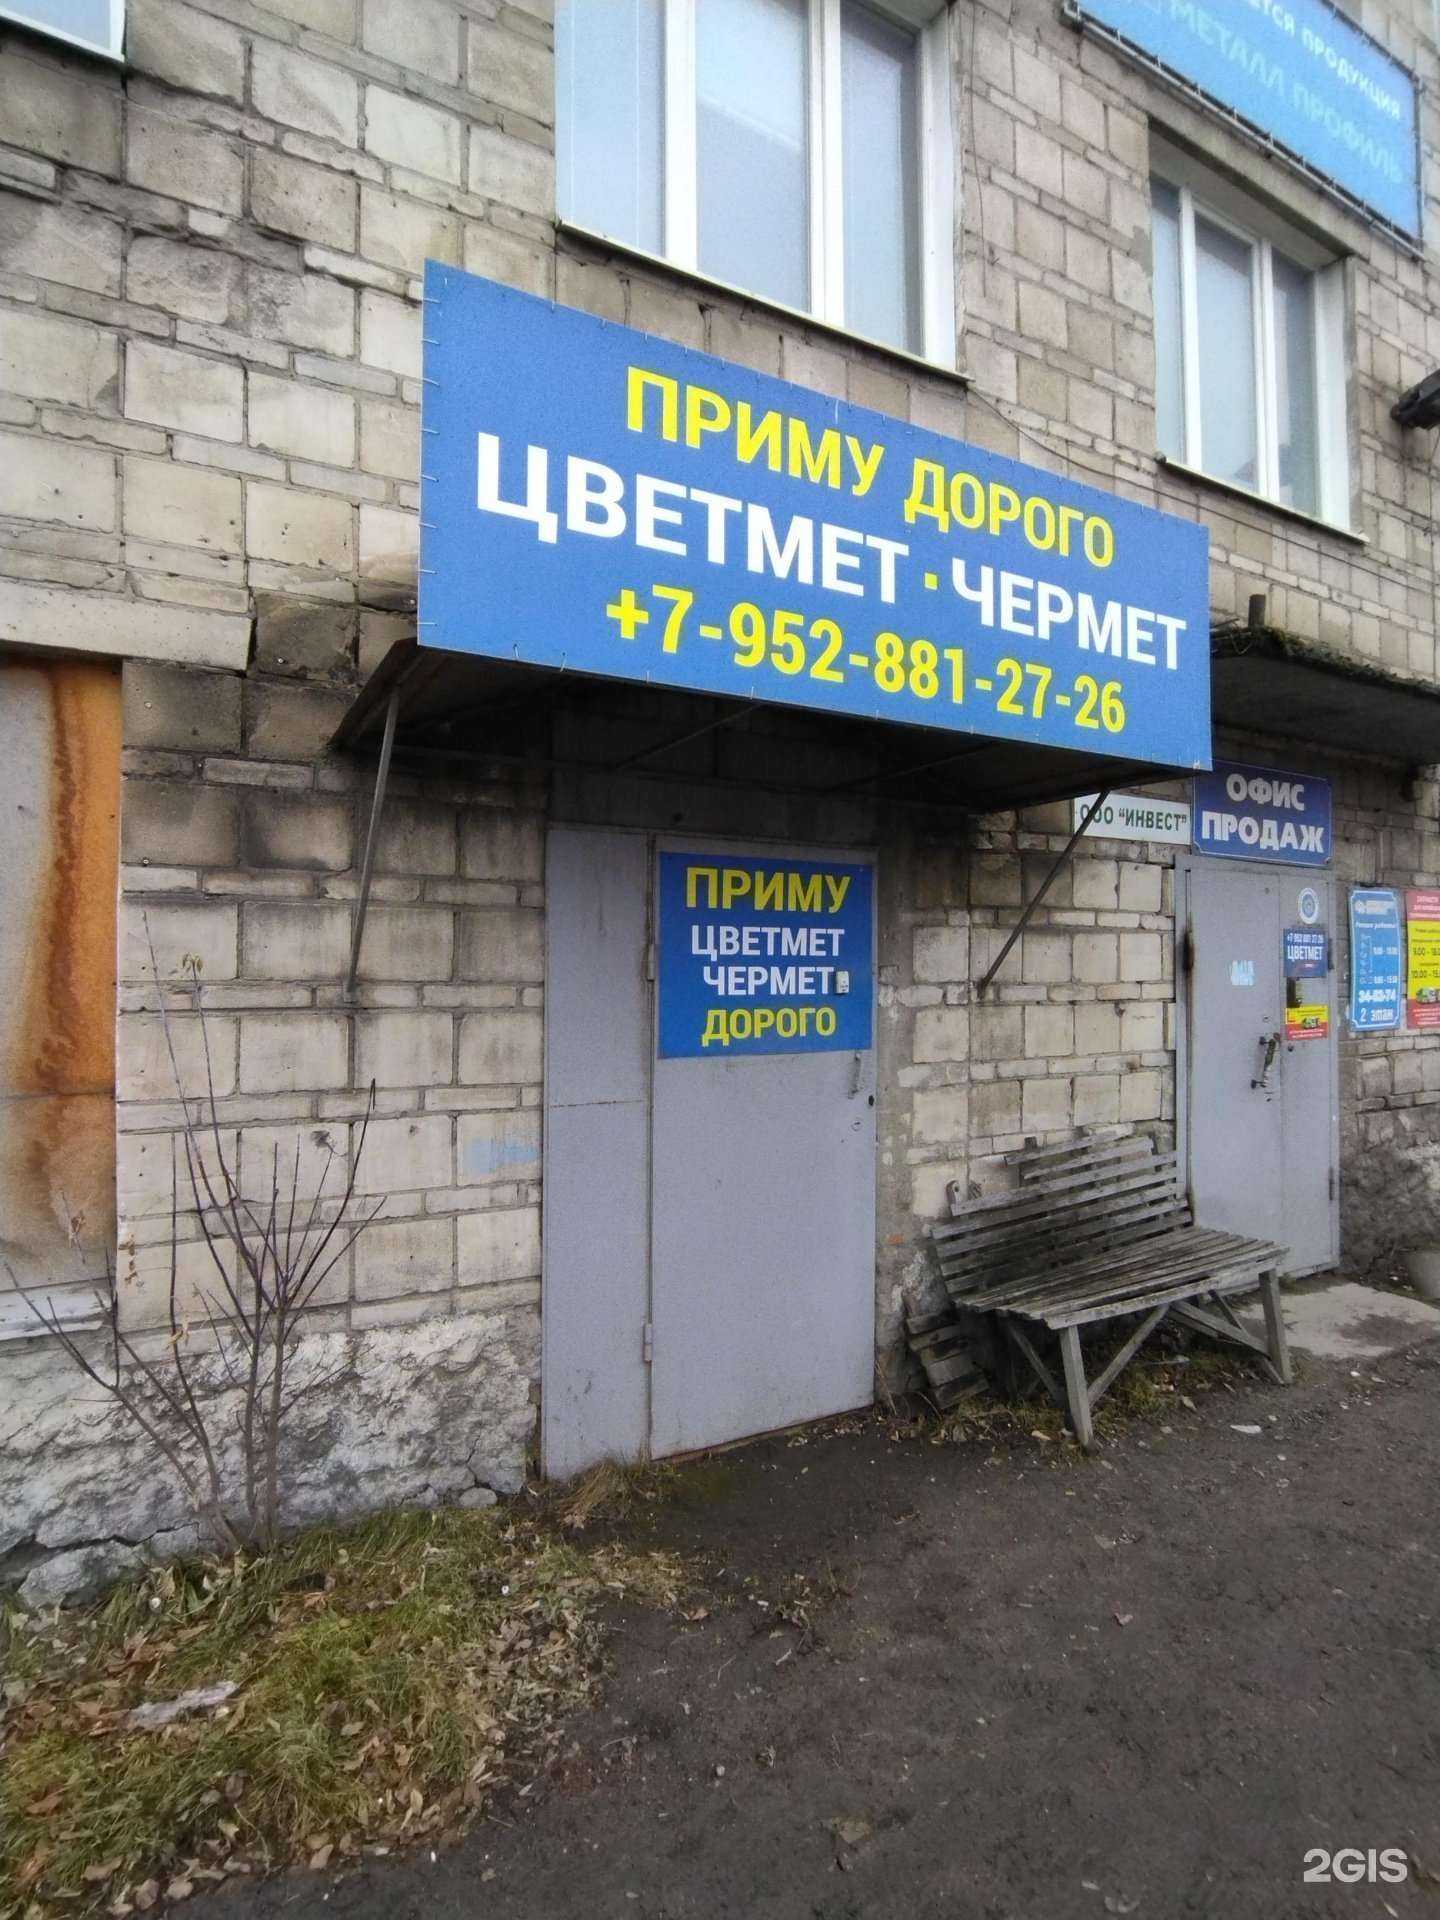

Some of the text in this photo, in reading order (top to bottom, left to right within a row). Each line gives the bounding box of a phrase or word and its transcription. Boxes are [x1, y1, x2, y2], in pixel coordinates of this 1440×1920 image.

[1170, 0, 1402, 184] МЕТАЛЛ ПРОФИЛЬ
[1301, 26, 1400, 121] ПРОДУКЦИЯ
[626, 366, 1114, 568] ПРИМУ ДОРОГО
[477, 432, 1187, 670] ЦВЕТМЕТ ЧЕРМЕТ
[606, 584, 1126, 733] +7-952-881-27-26
[1226, 773, 1305, 811] ОФИС
[1080, 804, 1114, 825] ООО
[1202, 811, 1325, 853] ПРОДАЖ
[686, 867, 850, 913] ПРИМУ
[691, 925, 845, 961] ЦВЕТМЕТ
[1287, 945, 1323, 962] ЦВЕТМЕТ
[703, 966, 835, 995] ЧЕРМЕТ
[701, 1007, 836, 1047] ДОРОГО
[1360, 1007, 1366, 1022] 2
